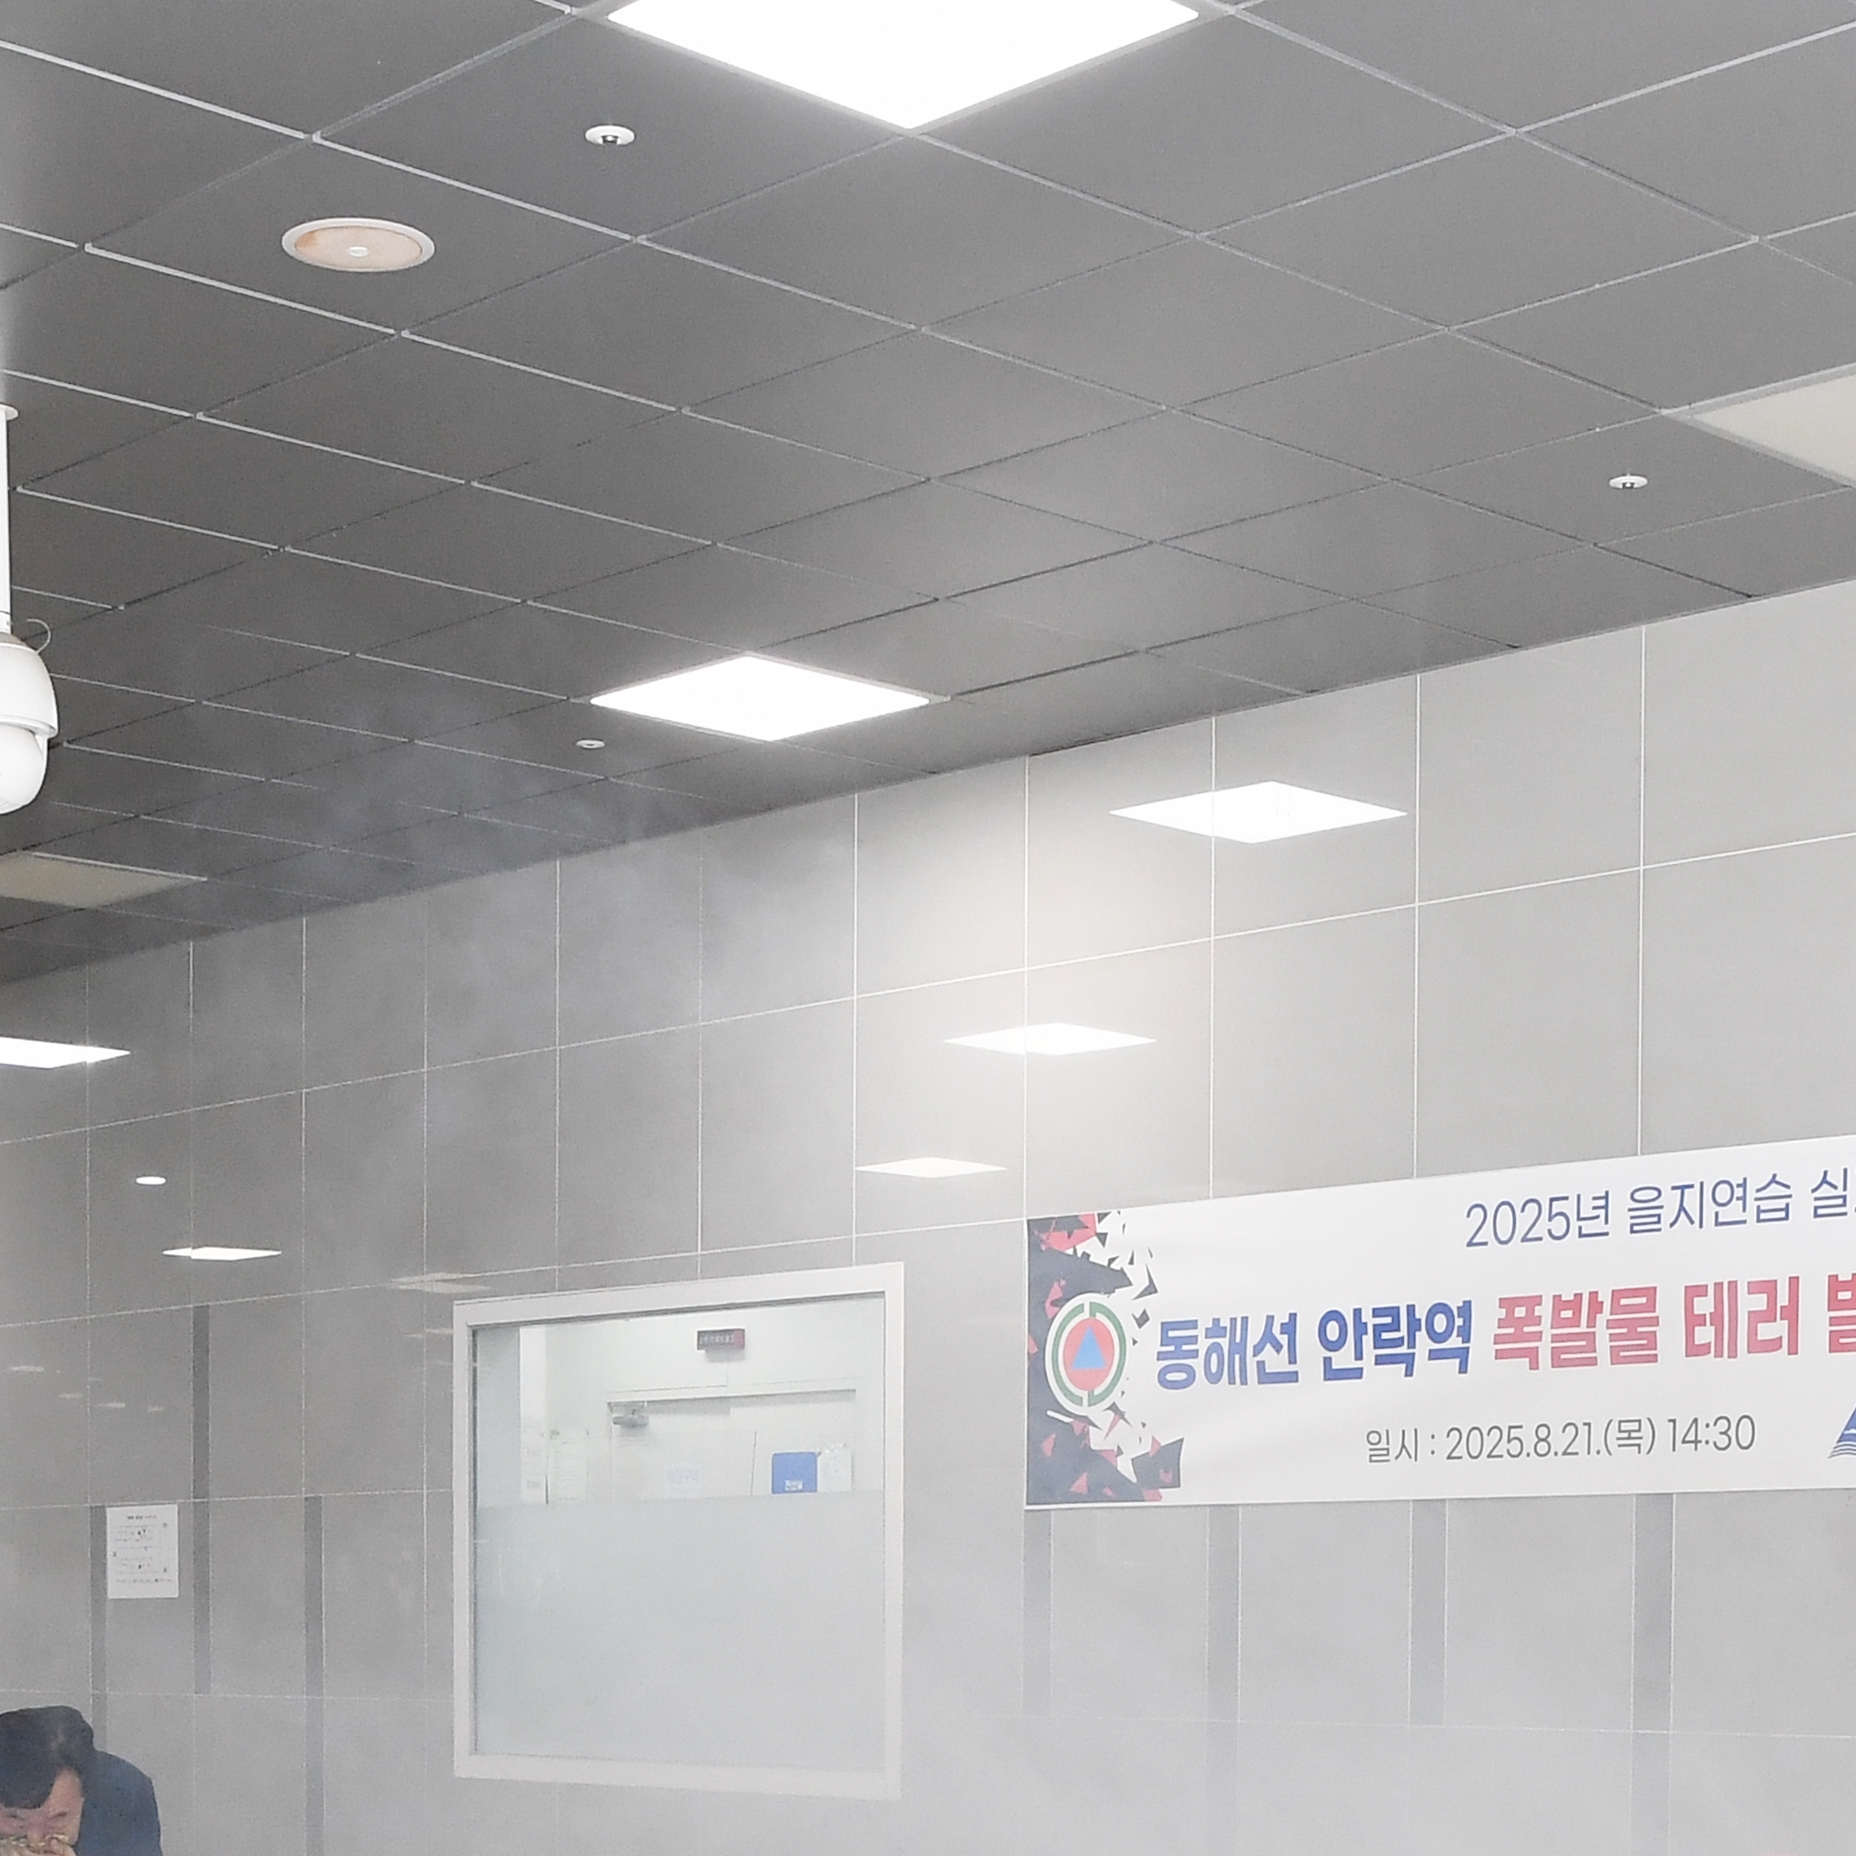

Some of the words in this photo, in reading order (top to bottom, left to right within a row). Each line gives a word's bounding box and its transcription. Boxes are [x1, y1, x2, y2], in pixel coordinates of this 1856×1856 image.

[1465, 1189, 1612, 1250] 2025년
[1626, 1172, 1795, 1236] 을지연습
[1155, 1312, 1300, 1391] 동해선
[1317, 1299, 1475, 1383] 안락역
[1492, 1285, 1661, 1372] 폭발물
[1683, 1275, 1802, 1361] 테러
[1366, 1427, 1420, 1465] 일시
[1445, 1416, 1658, 1462] 2025.8.21.(목)
[1667, 1414, 1757, 1454] 14:30
